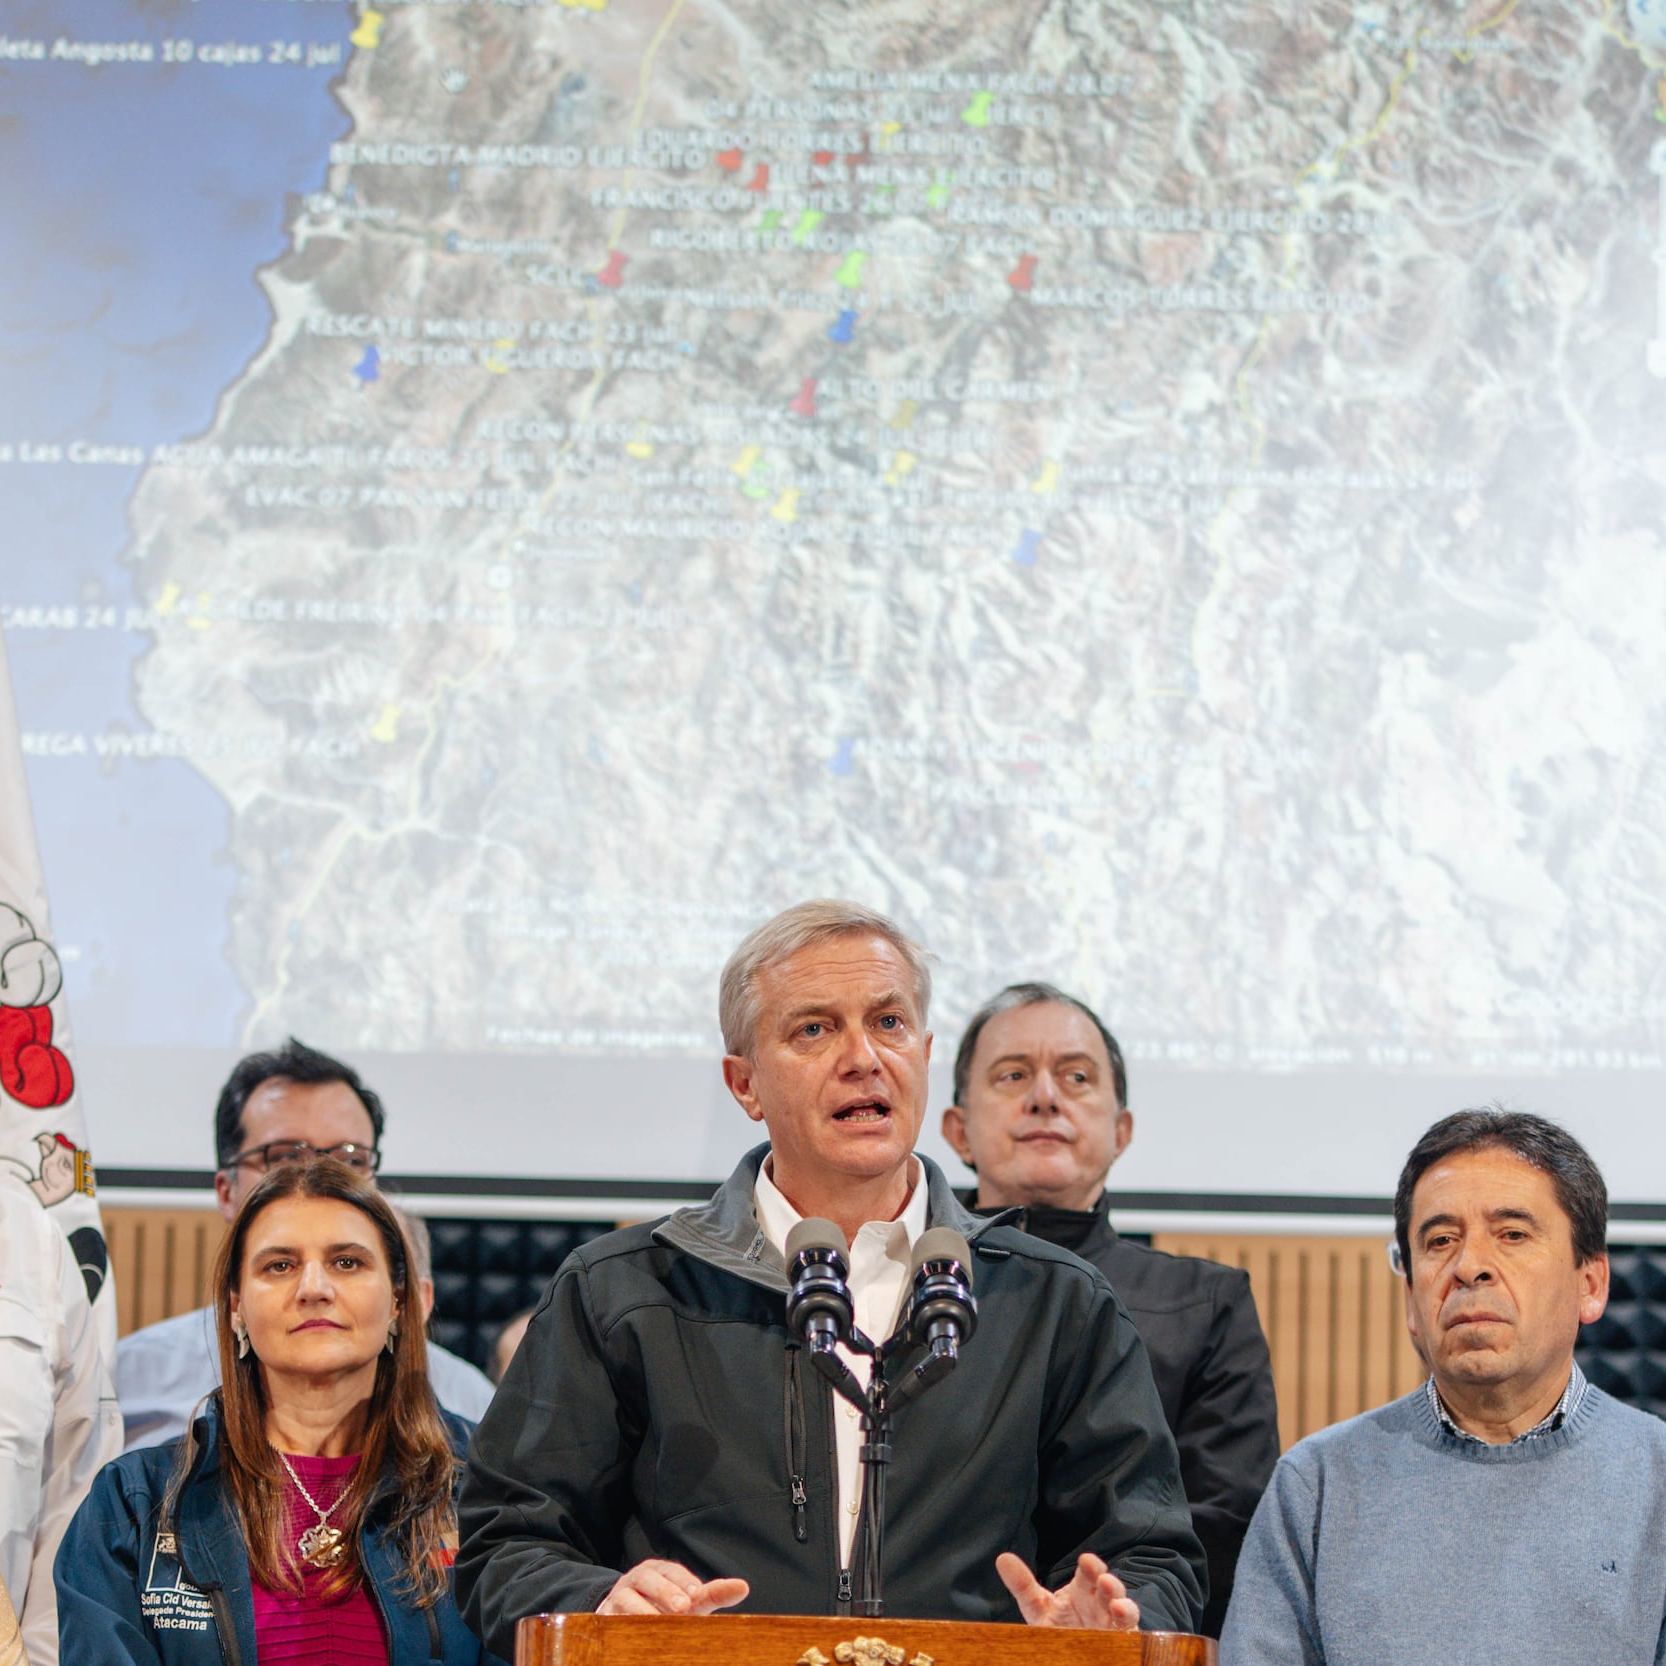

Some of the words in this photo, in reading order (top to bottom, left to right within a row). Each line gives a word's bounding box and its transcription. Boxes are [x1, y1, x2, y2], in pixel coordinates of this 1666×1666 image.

[50, 37, 153, 66] Angosta
[160, 40, 192, 62] 10
[197, 43, 261, 66] cajas
[267, 41, 302, 64] 24
[307, 40, 340, 67] jul
[636, 131, 757, 152] EDUARDO
[588, 145, 706, 169] EJERCITO
[893, 380, 938, 400] DEL
[19, 443, 62, 464] Las
[68, 442, 144, 466] Canas
[83, 607, 116, 631] 24
[163, 1592, 180, 1604] Cid
[153, 1616, 208, 1631] Atacama
